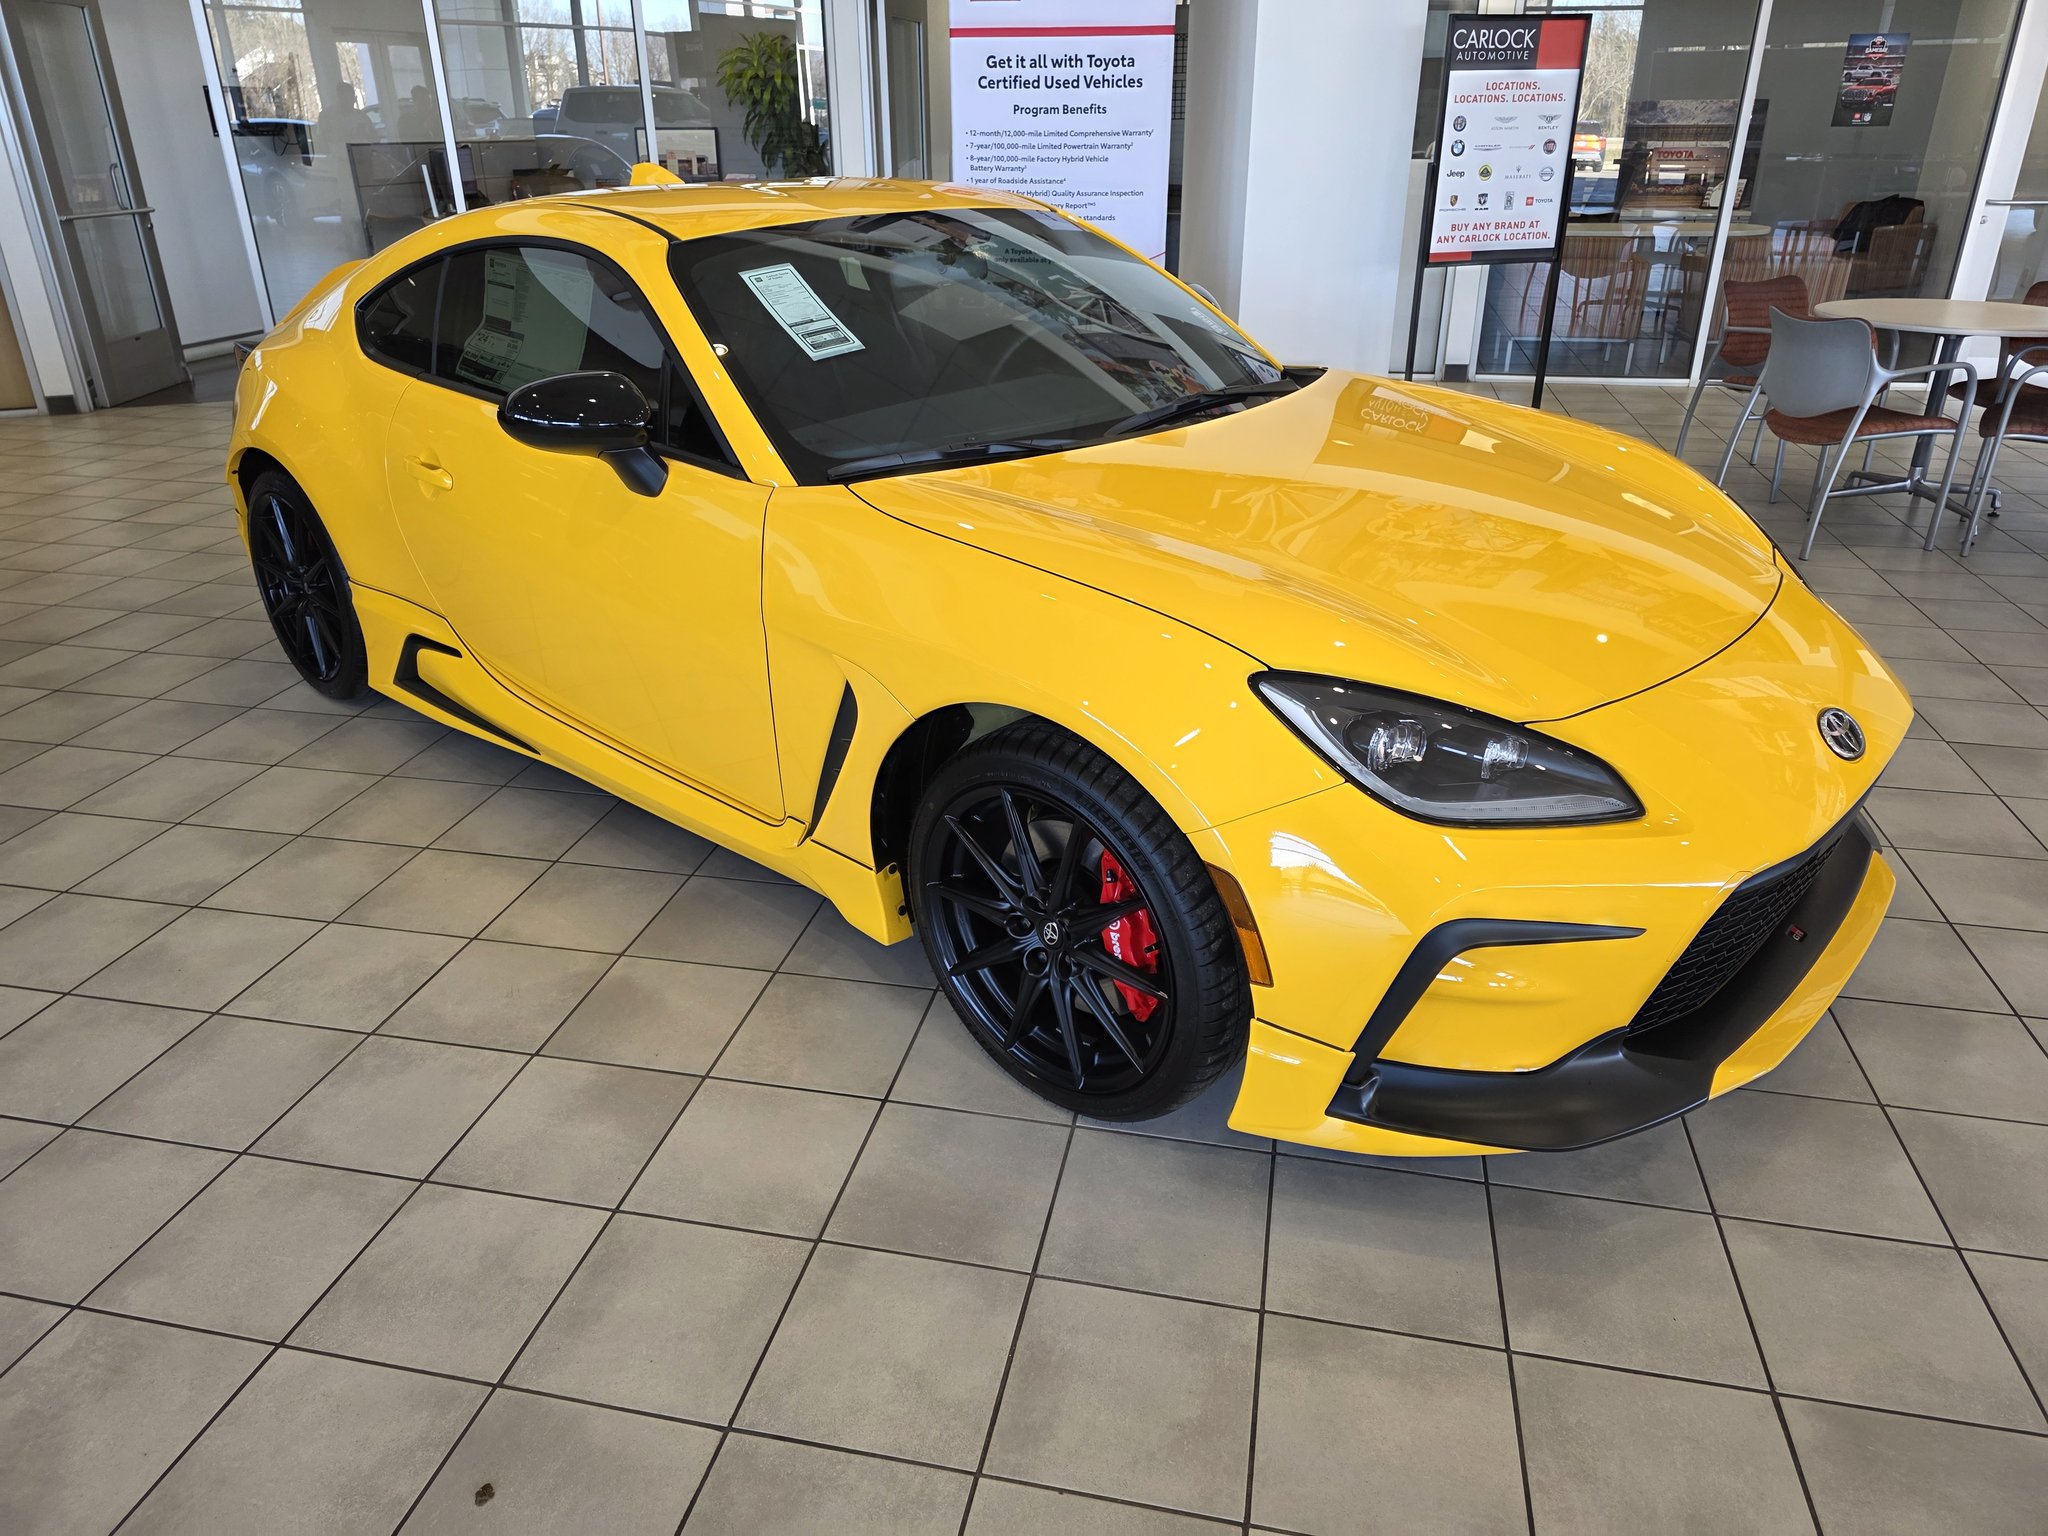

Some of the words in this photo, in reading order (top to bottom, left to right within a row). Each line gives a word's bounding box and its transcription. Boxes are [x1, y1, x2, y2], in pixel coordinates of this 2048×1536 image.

[1453, 28, 1537, 48] CARLOCK
[1456, 51, 1529, 60] AUTOMOTIVE
[986, 56, 1012, 68] Get
[1016, 55, 1025, 68] it
[1030, 54, 1046, 68] all
[1051, 54, 1082, 68] with
[1087, 54, 1135, 71] Toyota
[978, 76, 1040, 89] Certified
[1044, 76, 1079, 89] Used
[1084, 75, 1143, 89] Vehicles
[1486, 81, 1541, 91] LOCATIONS.
[1454, 94, 1509, 103] LOCATIONS.
[1512, 93, 1566, 102] LOCATIONS.
[1013, 105, 1059, 117] Program
[1062, 104, 1106, 114] Benefits
[969, 129, 1042, 138] 12-month/12,000-mile
[1044, 129, 1068, 137] Limited
[1069, 130, 1120, 139] Comprehensive
[970, 143, 1036, 151] 7-year/100,000-mile
[1657, 150, 1694, 158] TOYOTA
[970, 155, 1035, 164] 8-year/100,000-mile
[1036, 155, 1061, 164] Factory
[1062, 155, 1084, 164] Hybrid
[1447, 170, 1465, 178] Jeep
[974, 178, 988, 186] year
[1026, 189, 1050, 198] Hybrid)
[1052, 189, 1075, 198] Quality
[1110, 189, 1144, 198] Inspection
[1451, 223, 1469, 232] BUY
[1472, 222, 1491, 231] ANY
[1494, 221, 1526, 230] BRAND
[1528, 221, 1540, 229] AT
[1437, 234, 1456, 243] ANY
[1459, 233, 1501, 242] CARLOCK
[1504, 232, 1550, 241] LOCATION.
[1011, 248, 1032, 256] Toyota
